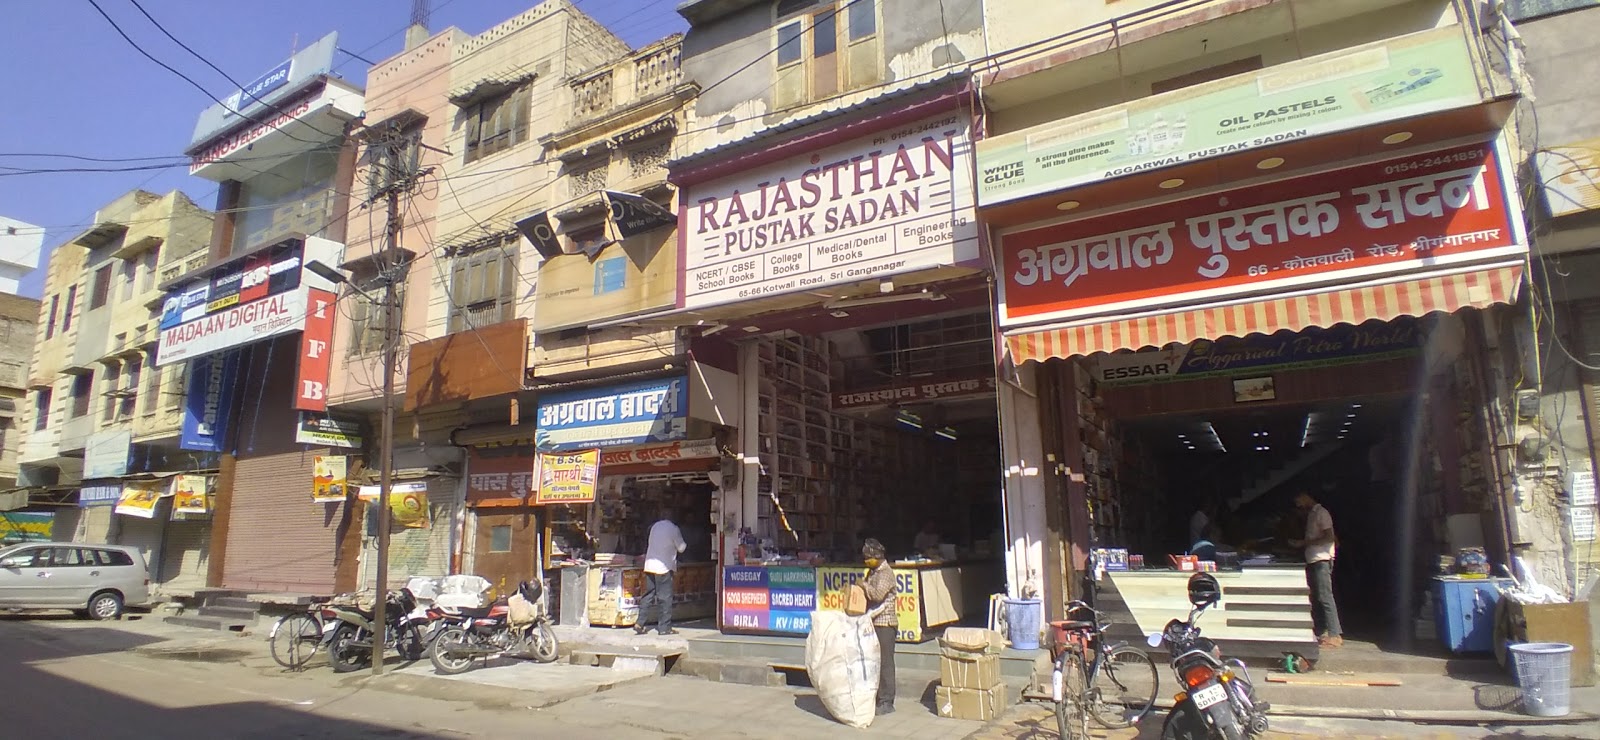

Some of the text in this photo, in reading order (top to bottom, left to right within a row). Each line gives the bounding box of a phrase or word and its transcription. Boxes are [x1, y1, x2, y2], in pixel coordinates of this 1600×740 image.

[264, 69, 286, 87] STAR
[1216, 127, 1237, 136] Create
[1252, 118, 1276, 128] colours
[1287, 110, 1311, 122] mixing
[1318, 104, 1342, 116] colours
[1219, 96, 1336, 128] OIL PASTELS
[191, 101, 310, 173] MANOJ ELECTRONICS
[890, 116, 957, 142] 0154-2442192
[1042, 150, 1068, 164] strong
[1068, 146, 1086, 160] glue
[1087, 139, 1116, 153] makes
[1042, 147, 1112, 169] all the difference.
[1104, 156, 1184, 178] AGGARWAL
[1188, 140, 1249, 160] PUSTAK
[1254, 129, 1307, 146] SADAN
[1384, 148, 1485, 176] 0154-2441851
[984, 160, 1024, 176] WHITE
[984, 168, 1024, 185] GLUE
[697, 129, 956, 234] RAJASTHAN
[984, 177, 1026, 192] Strong Bond
[724, 186, 921, 256] PUSTAK SADAN
[902, 216, 967, 238] Engineering
[1014, 164, 1488, 288] अग्रवाल पुस्तक सदन
[918, 230, 954, 246] Books
[770, 251, 803, 267] College
[831, 250, 864, 264] Books
[1248, 264, 1268, 278] 66
[1282, 248, 1356, 274] कोतवाली
[1410, 227, 1502, 253] श्रीगंगानगर
[696, 267, 723, 282] NCERT
[731, 260, 756, 274] CBSE
[738, 258, 906, 298] 65-66 Kotwali Road, Sri Ganganagar
[772, 262, 800, 275] Books
[698, 272, 755, 292] School Books
[166, 294, 289, 348] MADAAN DIGITAL
[1188, 343, 1286, 370] Aggarwal
[1292, 337, 1343, 357] Petro
[1103, 362, 1170, 381] ESSAR
[540, 380, 682, 426] अग्रवाल ब्रादर्स
[838, 386, 917, 406] राजस्थान
[922, 379, 980, 398] पुस्तक
[636, 440, 682, 462] ब्रादर्स
[470, 472, 510, 491] पास
[731, 571, 762, 582] NOSEGAY
[726, 592, 767, 606] GOOD SHEPHERD
[772, 594, 813, 608] SACRED HEART
[734, 614, 759, 628] BIRLA
[776, 618, 788, 629] KV
[792, 618, 809, 630] BSF
